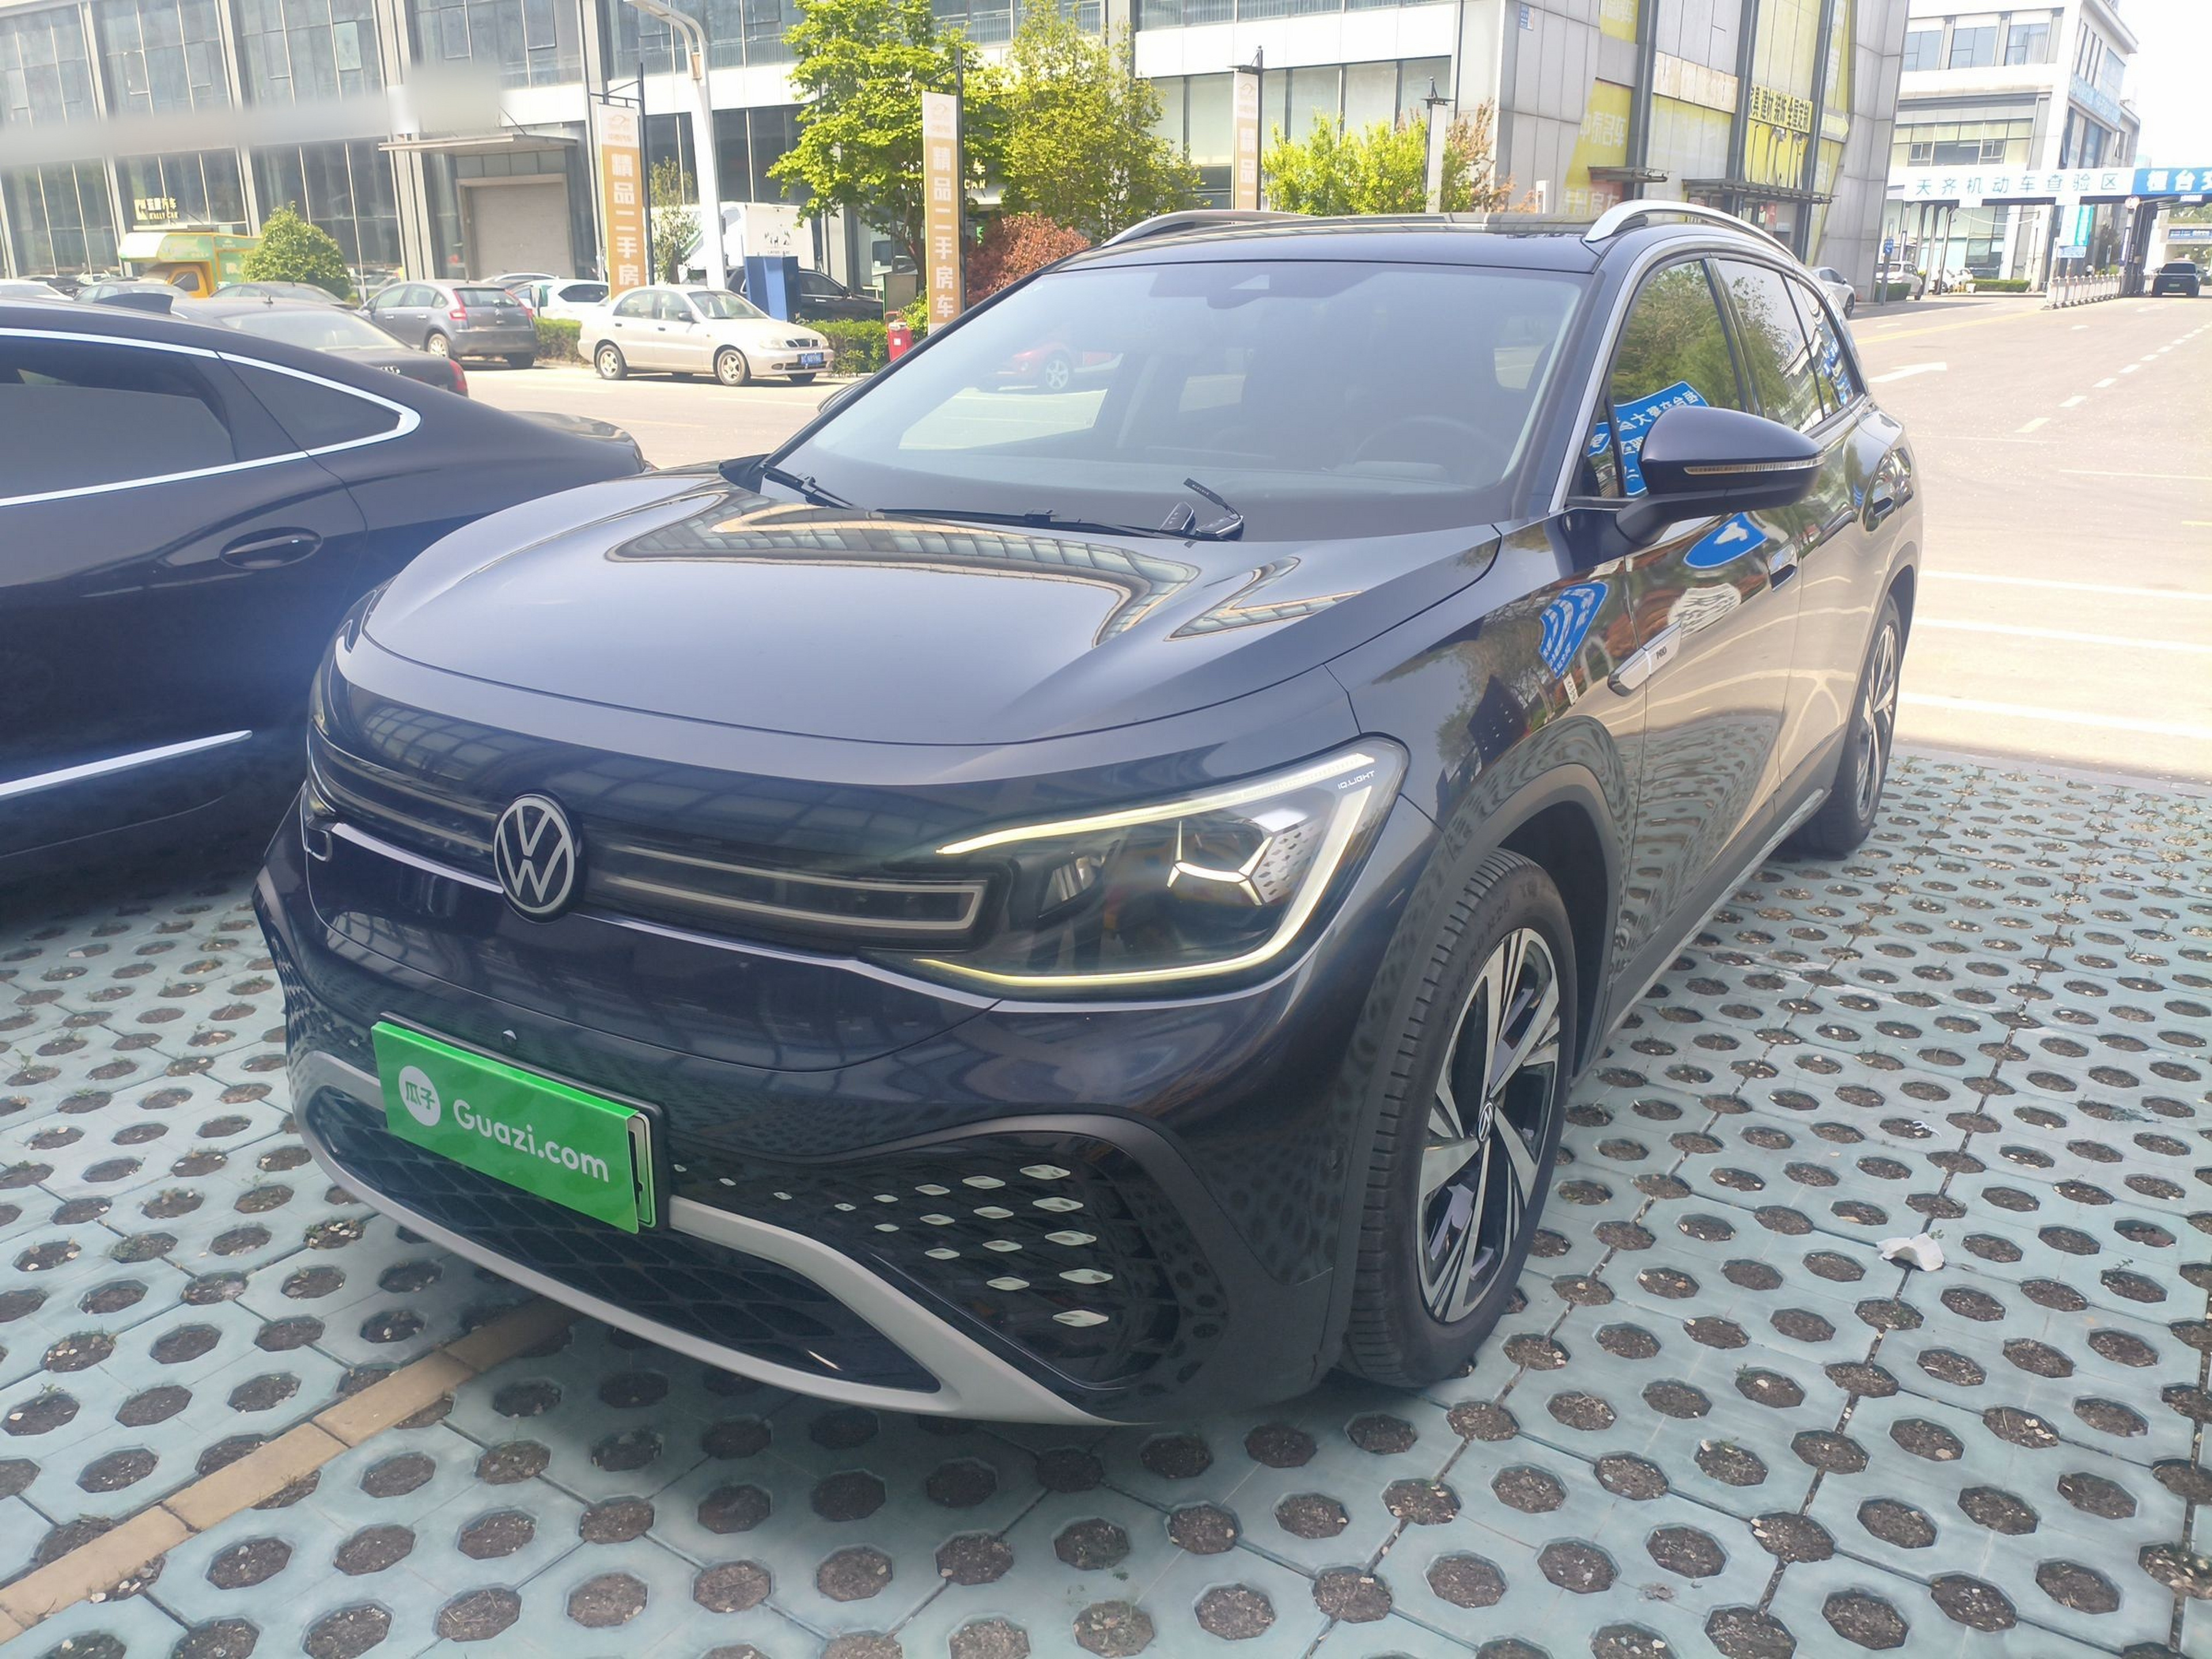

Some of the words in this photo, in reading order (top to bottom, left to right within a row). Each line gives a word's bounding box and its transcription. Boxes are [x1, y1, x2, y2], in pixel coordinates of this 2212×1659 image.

[1916, 173, 2118, 196] 天齐机动车查验区
[612, 154, 639, 286] 精品二手房
[933, 146, 954, 317] 精品二手房车
[1337, 770, 1375, 790] IQ.LIGHT
[406, 1081, 435, 1111] 瓜子
[453, 1099, 609, 1183] Guazi.com
